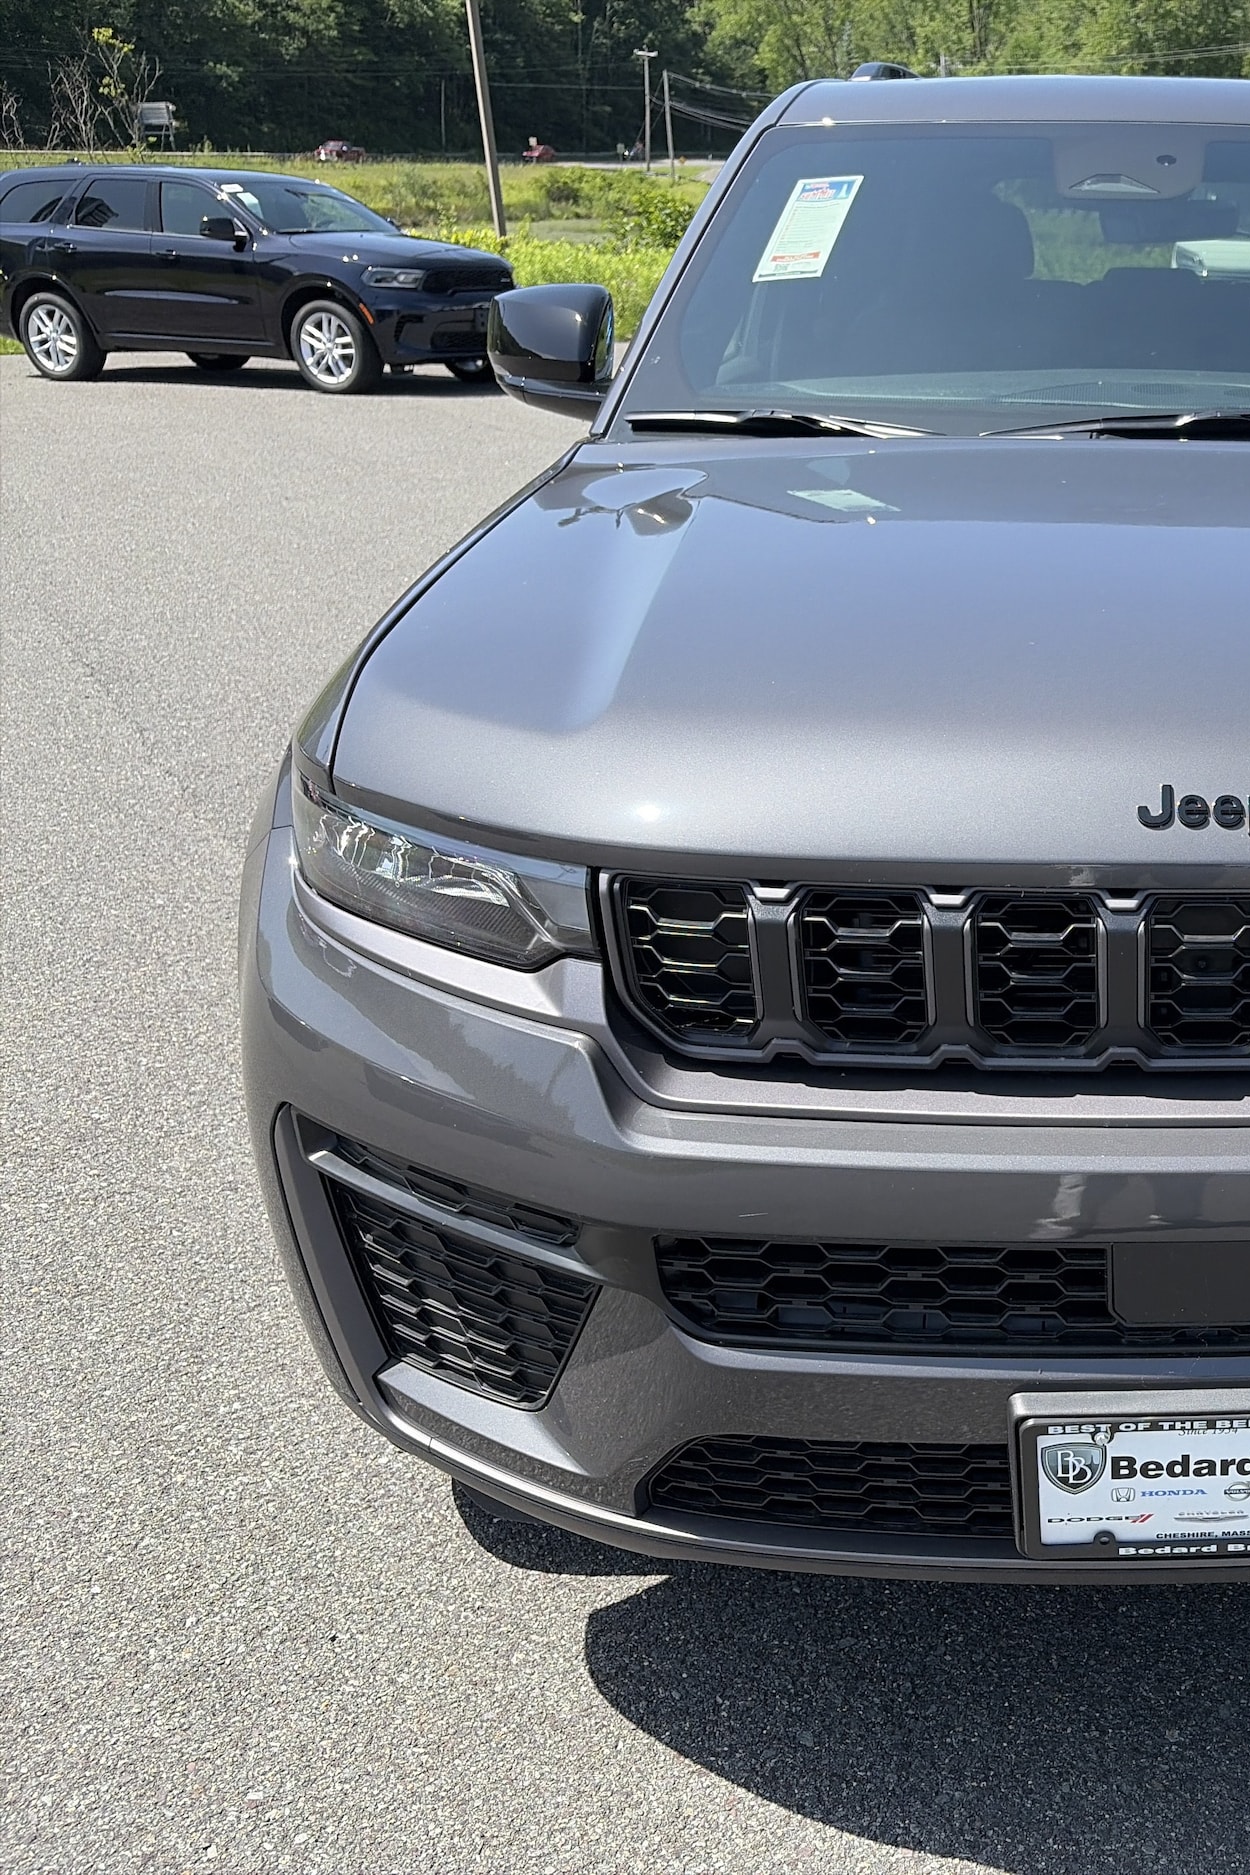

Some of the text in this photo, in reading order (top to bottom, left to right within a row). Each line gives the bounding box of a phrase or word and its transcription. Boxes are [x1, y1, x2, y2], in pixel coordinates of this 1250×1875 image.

[1048, 1424, 1112, 1435] BEST
[1118, 1422, 1152, 1432] OF
[1158, 1420, 1208, 1430] THE
[1140, 1489, 1208, 1497] HONDA
[1047, 1516, 1141, 1524] DODGE
[1156, 1531, 1218, 1539] CHESHIRE,
[1118, 1545, 1218, 1556] Bedard
